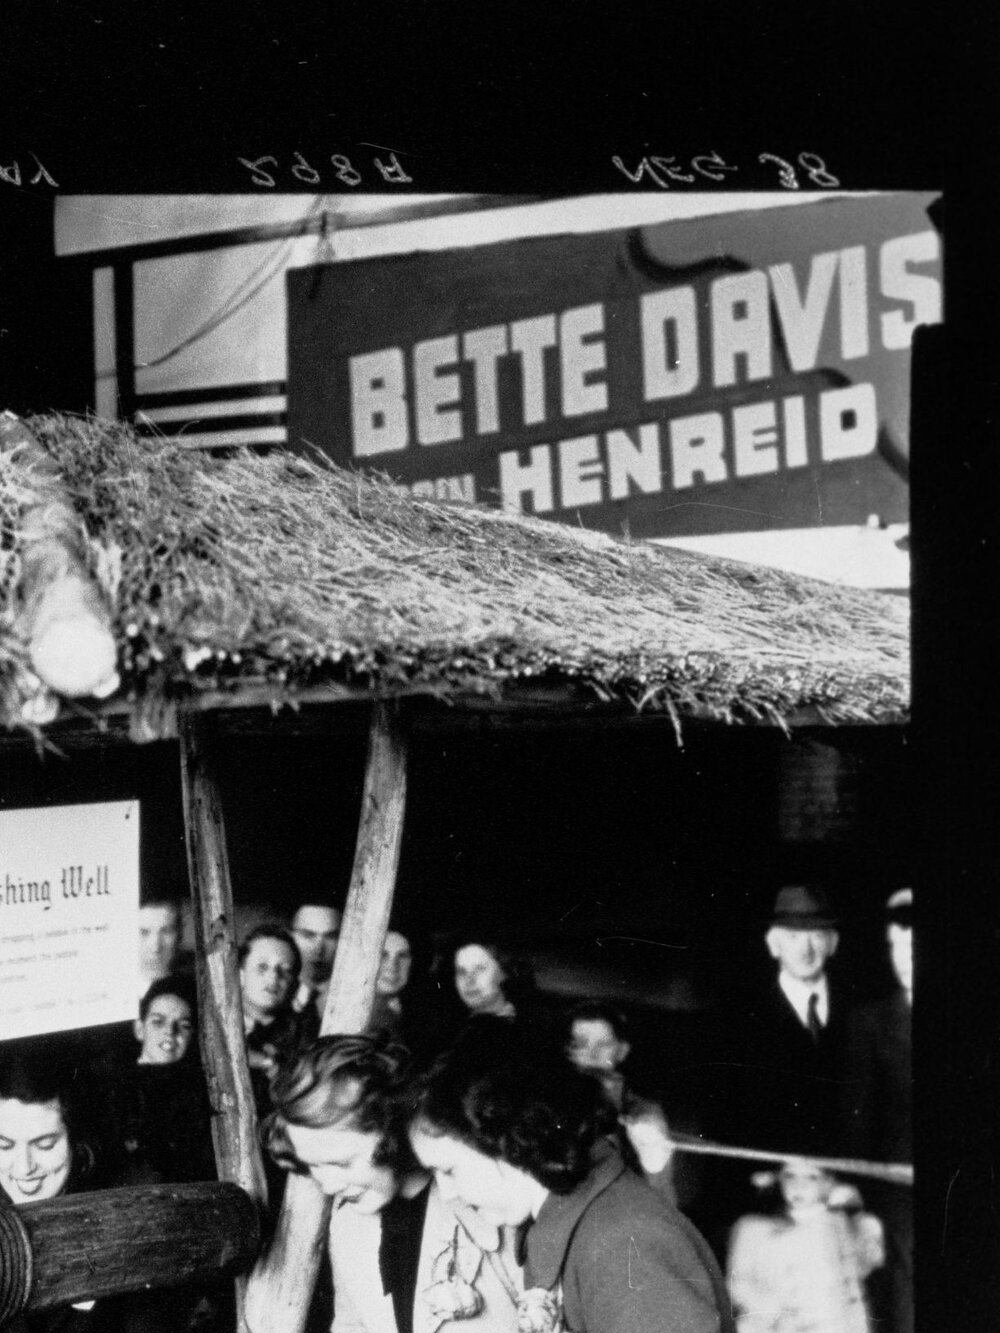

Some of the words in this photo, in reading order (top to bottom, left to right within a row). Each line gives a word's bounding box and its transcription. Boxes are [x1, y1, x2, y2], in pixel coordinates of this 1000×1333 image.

[349, 303, 608, 458] BETTE
[640, 230, 943, 403] DAVIS
[499, 383, 877, 515] HENREID
[60, 864, 111, 899] Well
